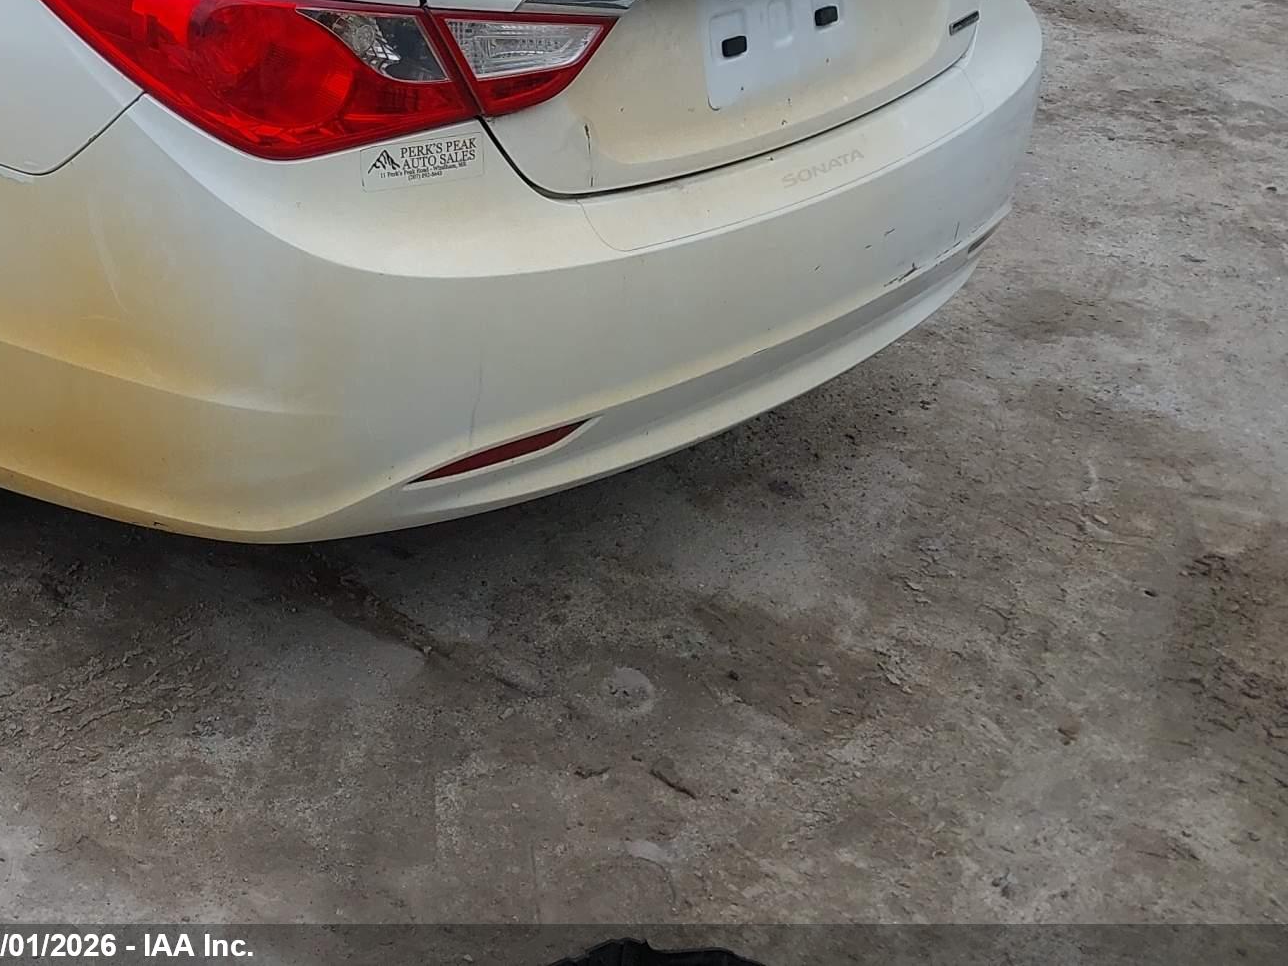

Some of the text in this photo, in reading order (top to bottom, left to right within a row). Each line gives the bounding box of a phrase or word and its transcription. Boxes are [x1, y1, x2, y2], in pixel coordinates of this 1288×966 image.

[400, 138, 477, 158] PERK'S PEAK
[403, 150, 476, 170] AUTO SALES
[782, 149, 864, 189] SONATA
